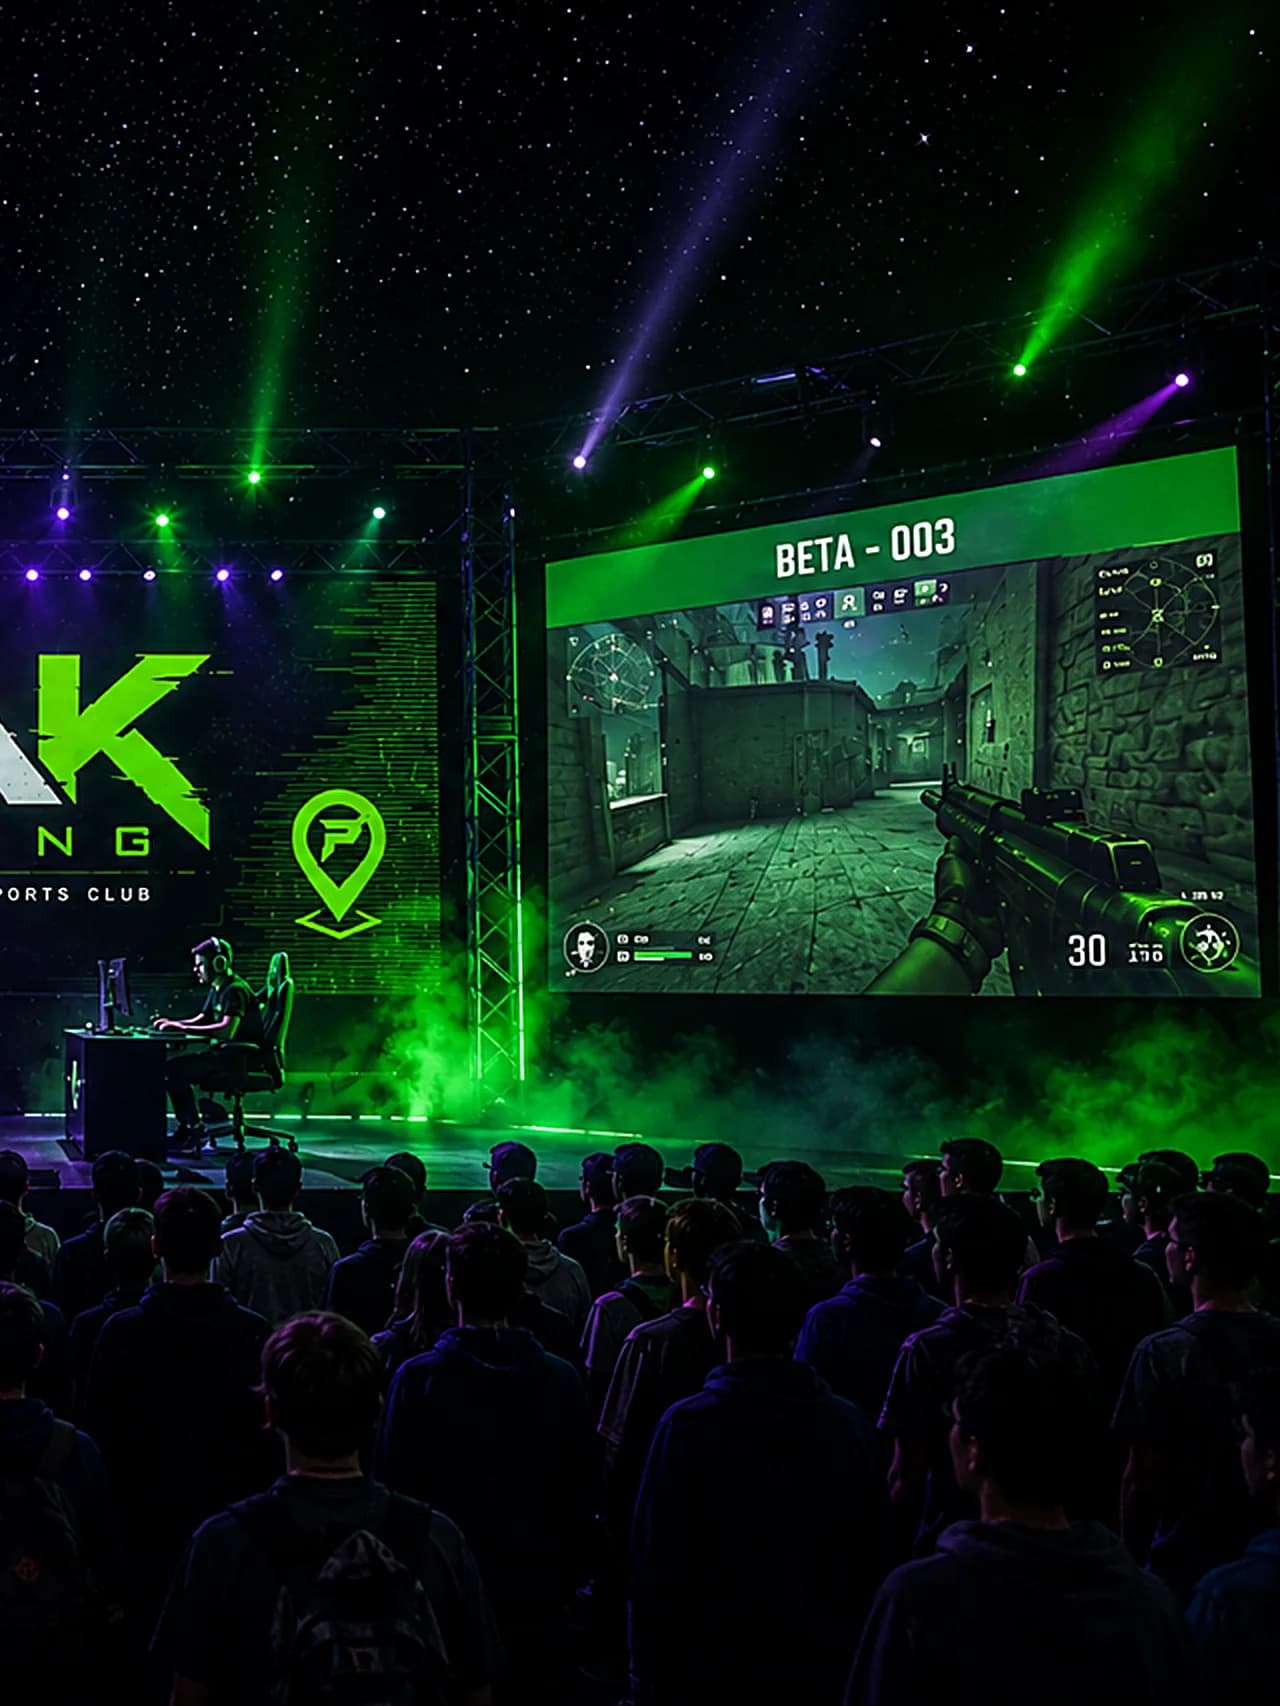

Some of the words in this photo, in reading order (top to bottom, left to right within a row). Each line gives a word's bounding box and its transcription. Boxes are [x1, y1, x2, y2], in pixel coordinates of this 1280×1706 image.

[776, 534, 856, 578] BETA
[891, 518, 955, 561] 003
[87, 886, 150, 902] CLUB
[1068, 933, 1107, 967] 30
